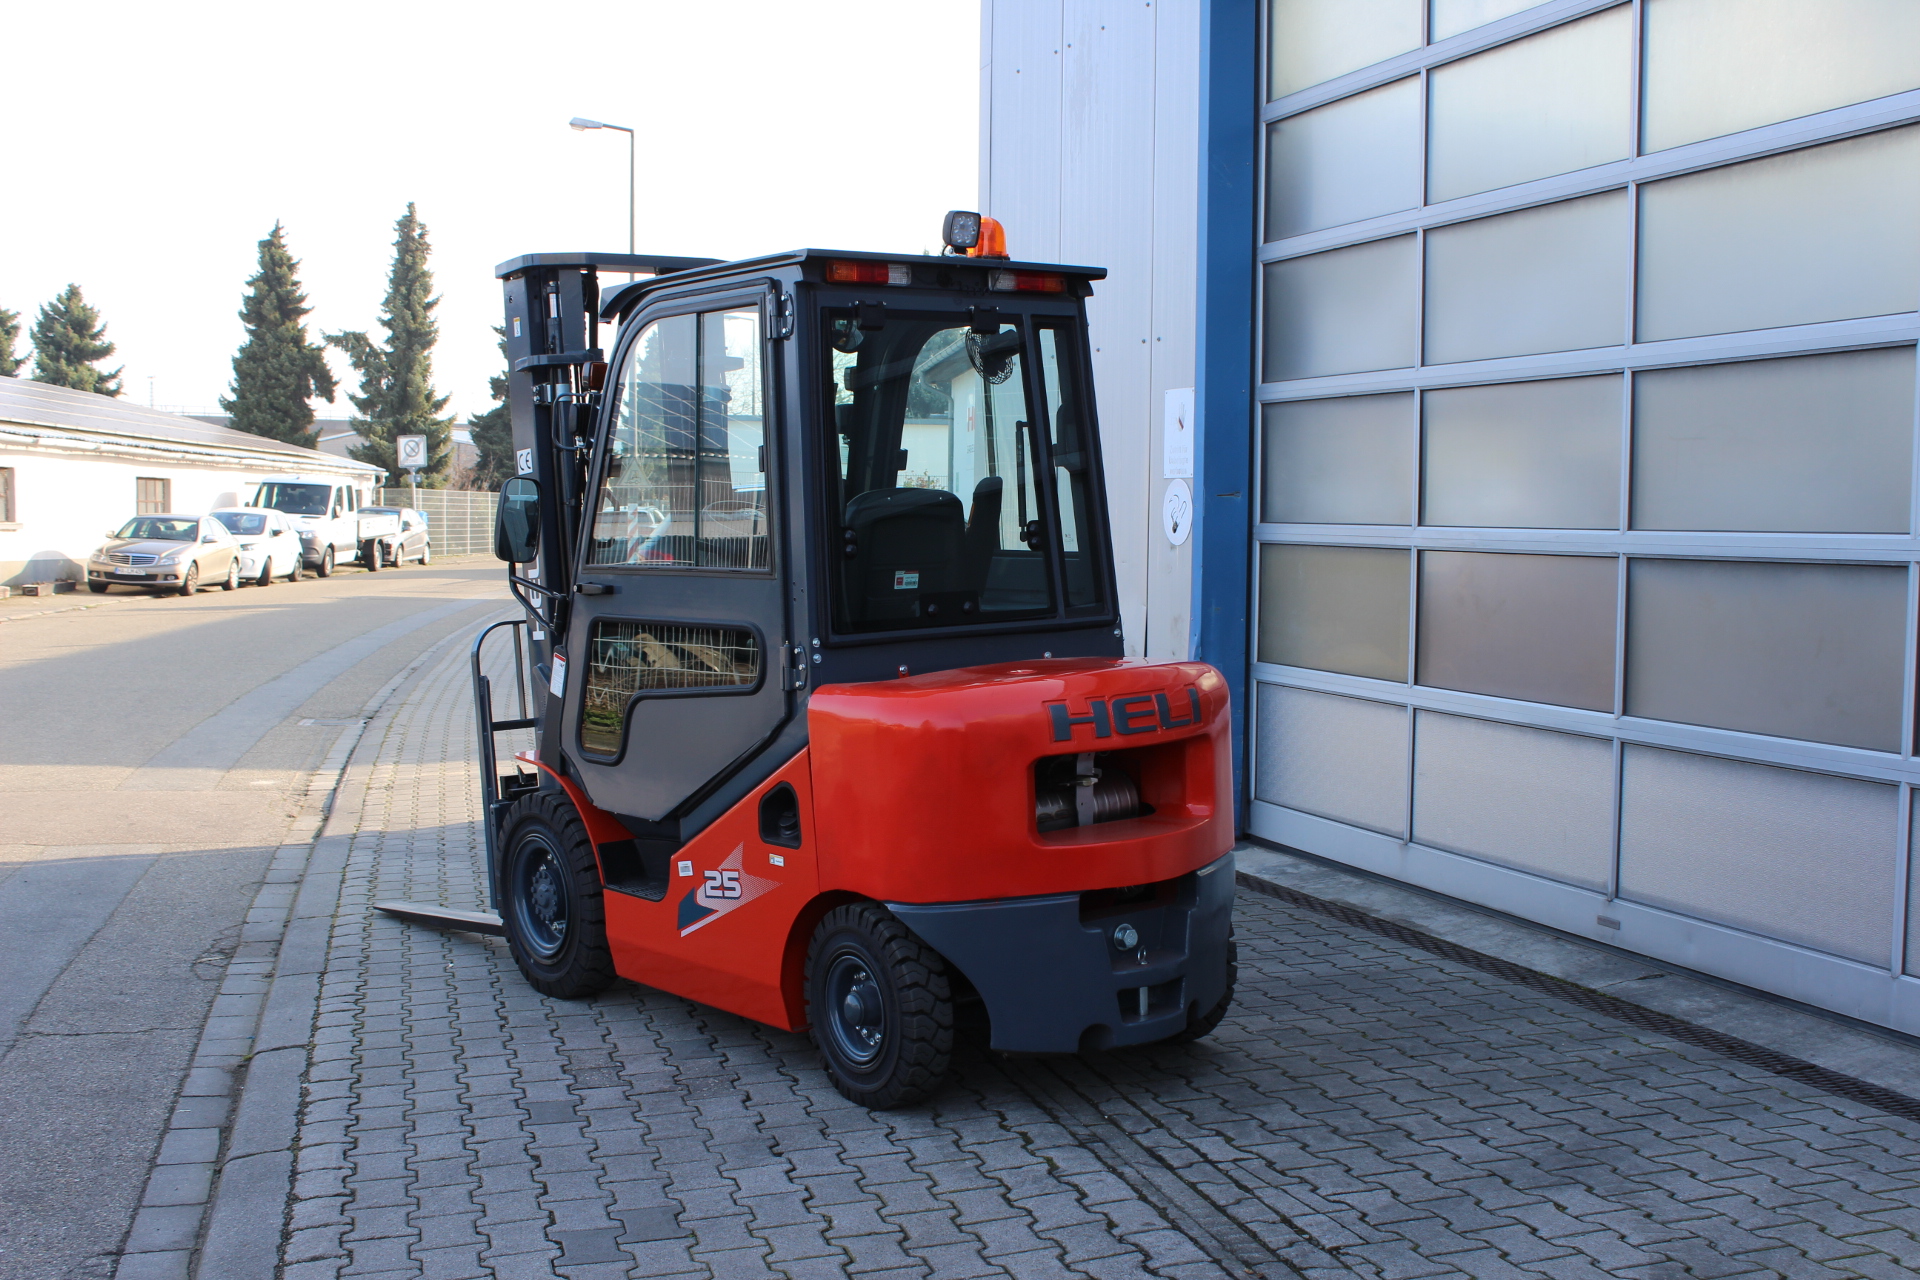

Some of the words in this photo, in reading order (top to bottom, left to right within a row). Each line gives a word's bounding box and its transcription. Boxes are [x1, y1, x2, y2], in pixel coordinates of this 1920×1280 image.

[518, 451, 532, 471] CE
[528, 554, 545, 640] HEL
[1049, 687, 1202, 742] HELI
[703, 869, 742, 900] 25
